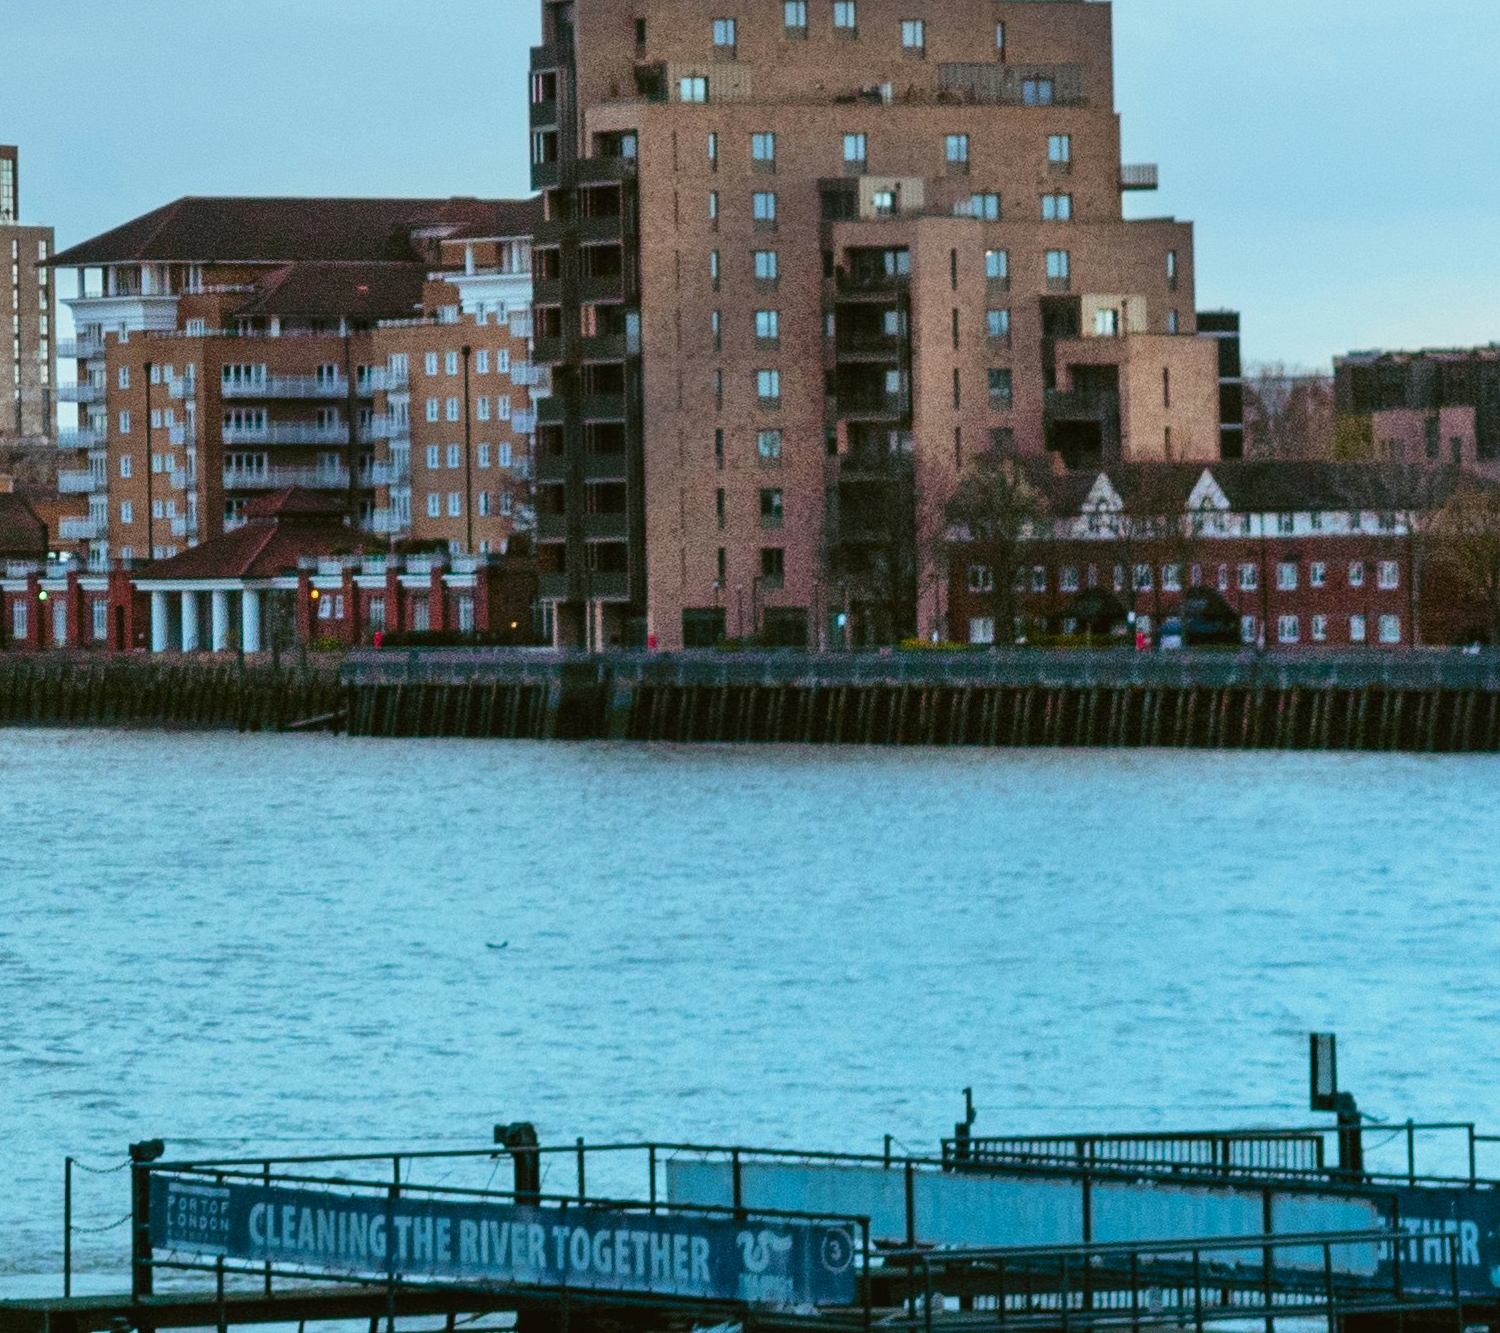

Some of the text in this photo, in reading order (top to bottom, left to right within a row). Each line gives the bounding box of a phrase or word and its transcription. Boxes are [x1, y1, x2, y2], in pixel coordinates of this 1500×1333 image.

[167, 1212, 230, 1231] LONDON
[250, 1202, 710, 1283] CLEANING THE RIVER TOGETHER
